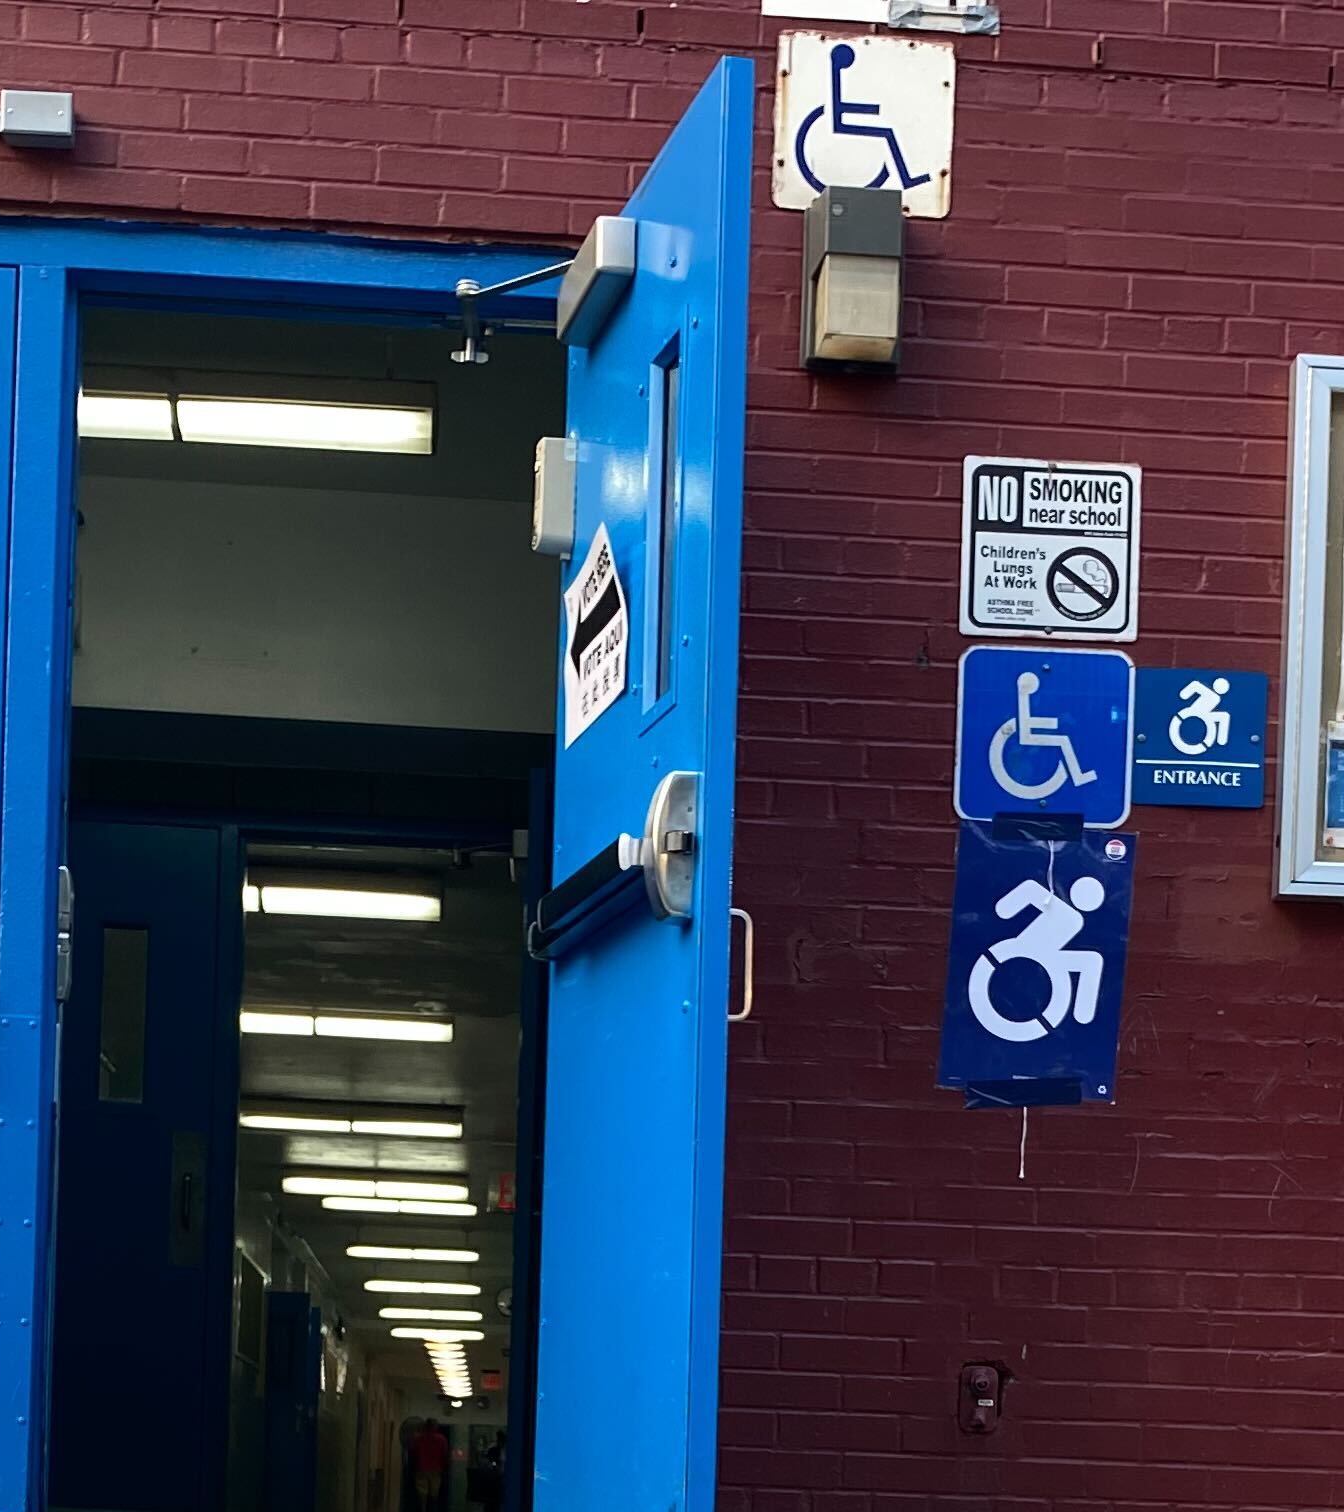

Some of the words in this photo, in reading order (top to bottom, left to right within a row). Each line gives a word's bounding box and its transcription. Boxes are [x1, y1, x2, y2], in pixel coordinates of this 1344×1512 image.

[977, 474, 1019, 523] NO
[1029, 477, 1123, 505] SMOKING
[1028, 507, 1066, 524] near
[1068, 506, 1122, 527] school
[980, 545, 1047, 561] Children's
[993, 560, 1033, 576] Lungs
[984, 576, 1001, 589] At
[1003, 575, 1038, 590] Work
[987, 607, 1014, 615] SCHOOL
[1017, 600, 1034, 608] FREE
[1153, 769, 1241, 787] ENTRANCE
